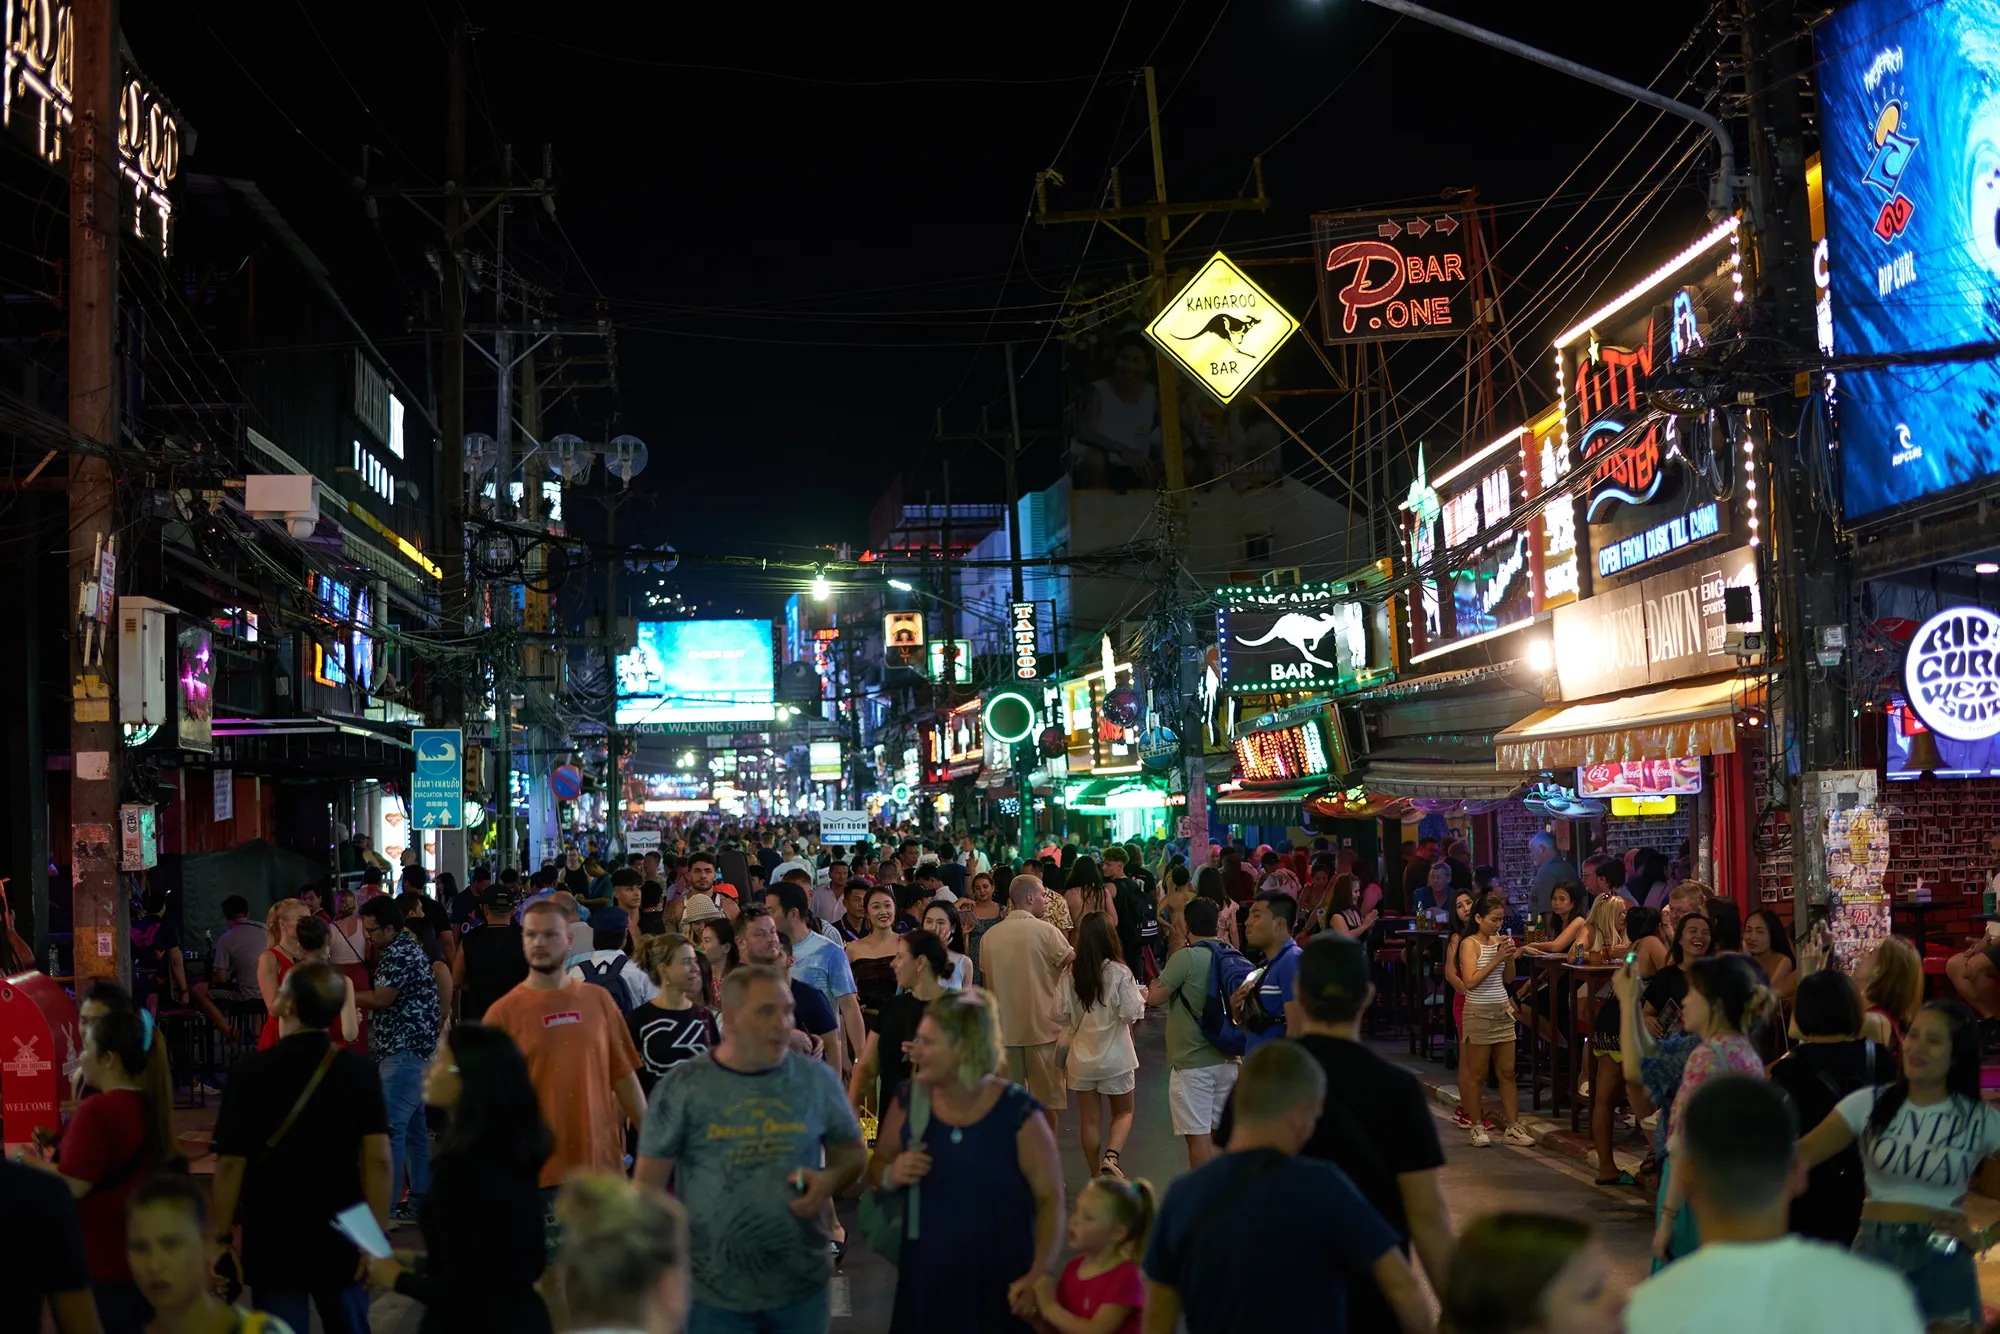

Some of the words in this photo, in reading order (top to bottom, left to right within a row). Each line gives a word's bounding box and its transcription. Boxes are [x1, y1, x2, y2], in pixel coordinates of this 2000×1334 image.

[1407, 254, 1465, 284] BAR
[1879, 263, 1893, 297] RIP
[1894, 249, 1916, 289] CURL
[1187, 294, 1256, 311] KANGAROO
[1210, 361, 1239, 375] BAR
[1892, 453, 1905, 467] RIP
[1904, 446, 1923, 462] CURL
[1599, 542, 1621, 576] OPEN
[1621, 533, 1645, 570] FROM
[1645, 523, 1671, 559] DUSK
[1670, 516, 1690, 549] TILL
[1690, 503, 1719, 541] DAWN
[1701, 578, 1725, 601] BIG
[1648, 586, 1702, 664] DAWN
[1919, 615, 1990, 656] RIP
[1013, 607, 1037, 679] TATTOO
[1271, 663, 1315, 680] BAR
[1916, 649, 2000, 685] CUR
[1921, 681, 1999, 705] WET
[668, 722, 724, 733] WALKING
[727, 721, 770, 731] STREET
[1854, 909, 1869, 925] 26
[5, 1102, 53, 1112] WELCOME
